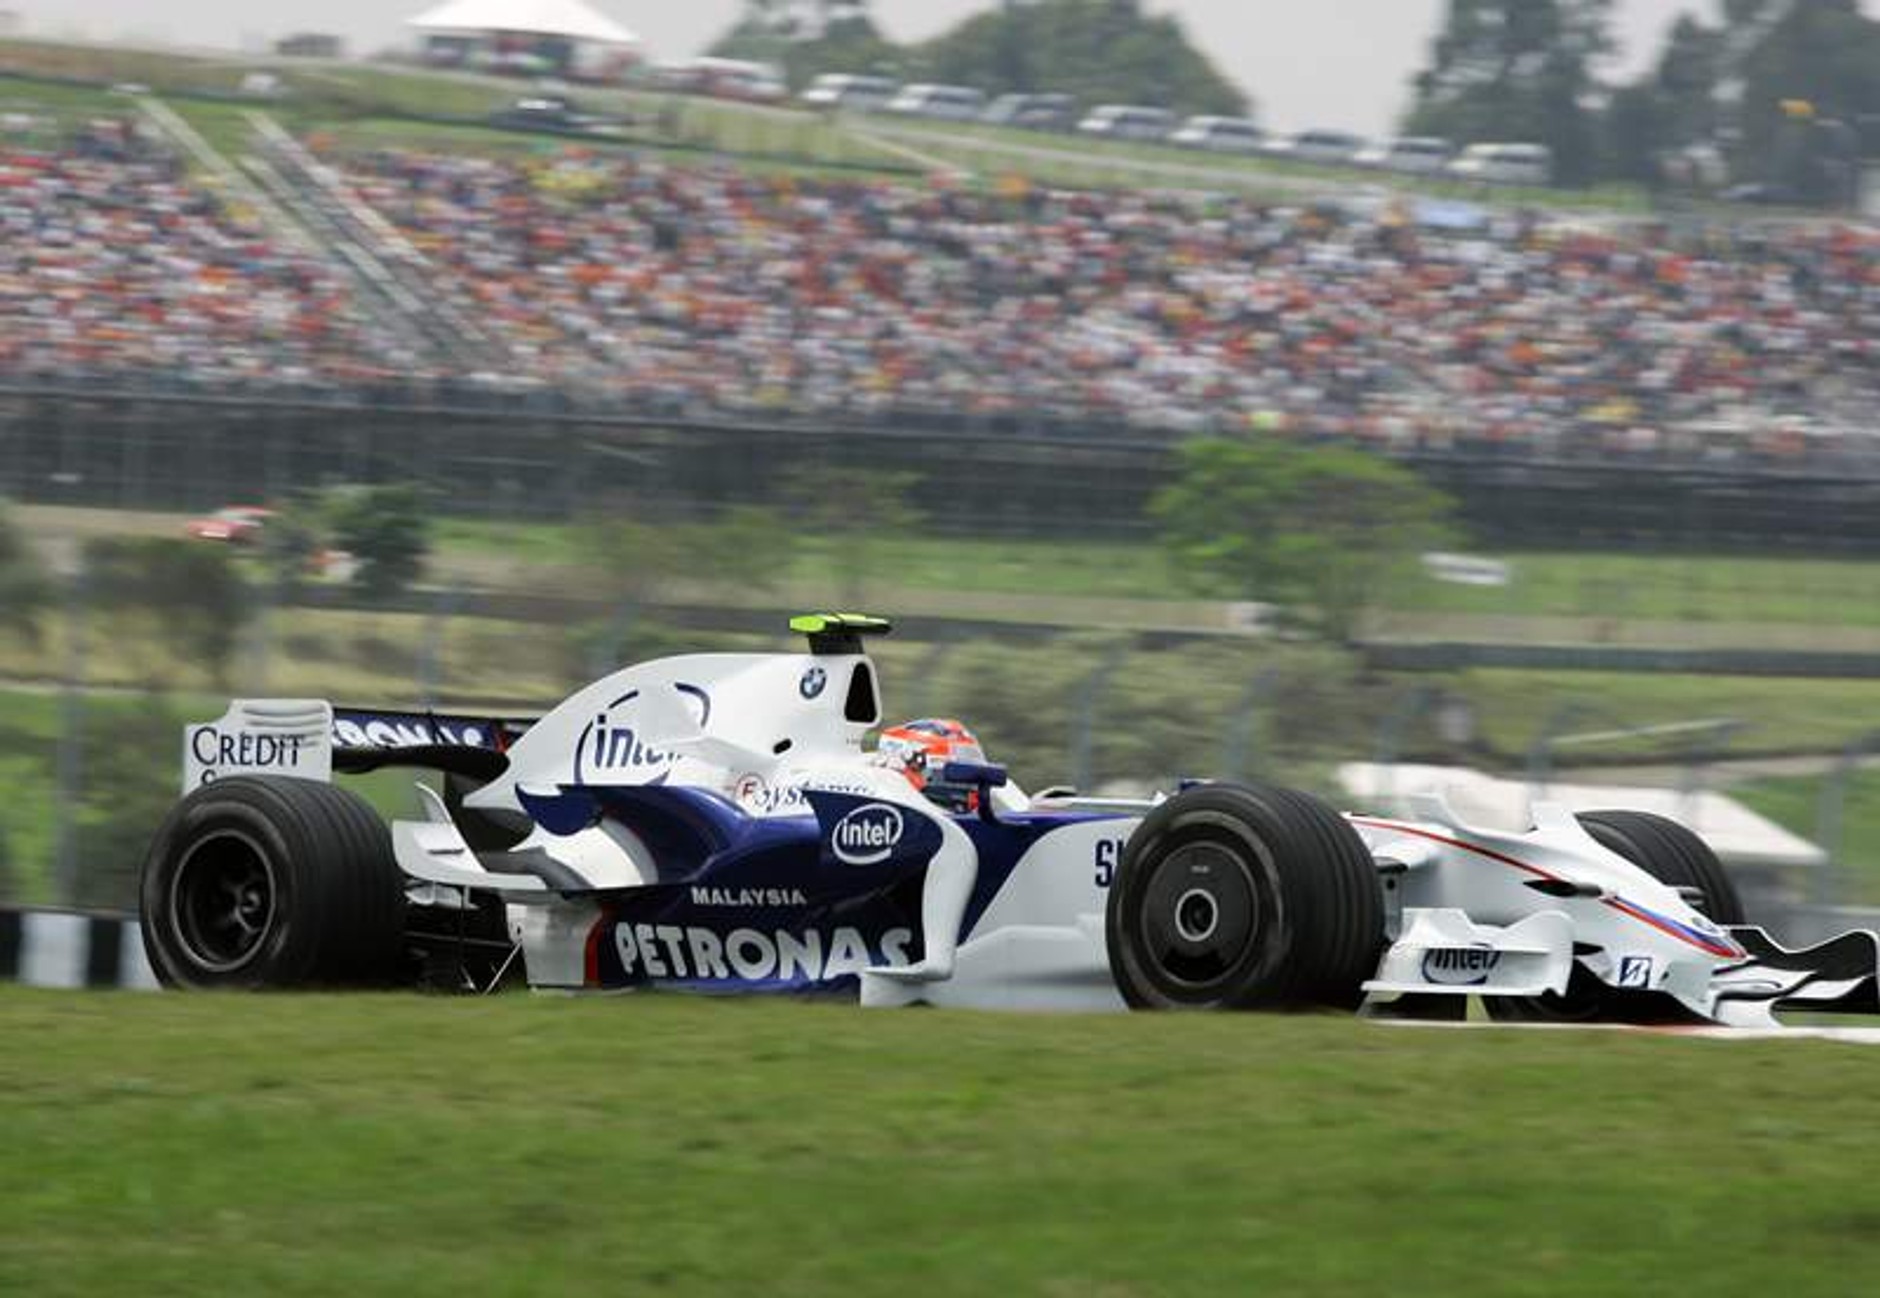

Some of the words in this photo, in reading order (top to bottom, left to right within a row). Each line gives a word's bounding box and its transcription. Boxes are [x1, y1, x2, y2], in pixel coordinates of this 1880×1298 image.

[842, 816, 890, 846] intel
[691, 886, 807, 906] MALAYSIA
[615, 921, 912, 980] PETRONAS
